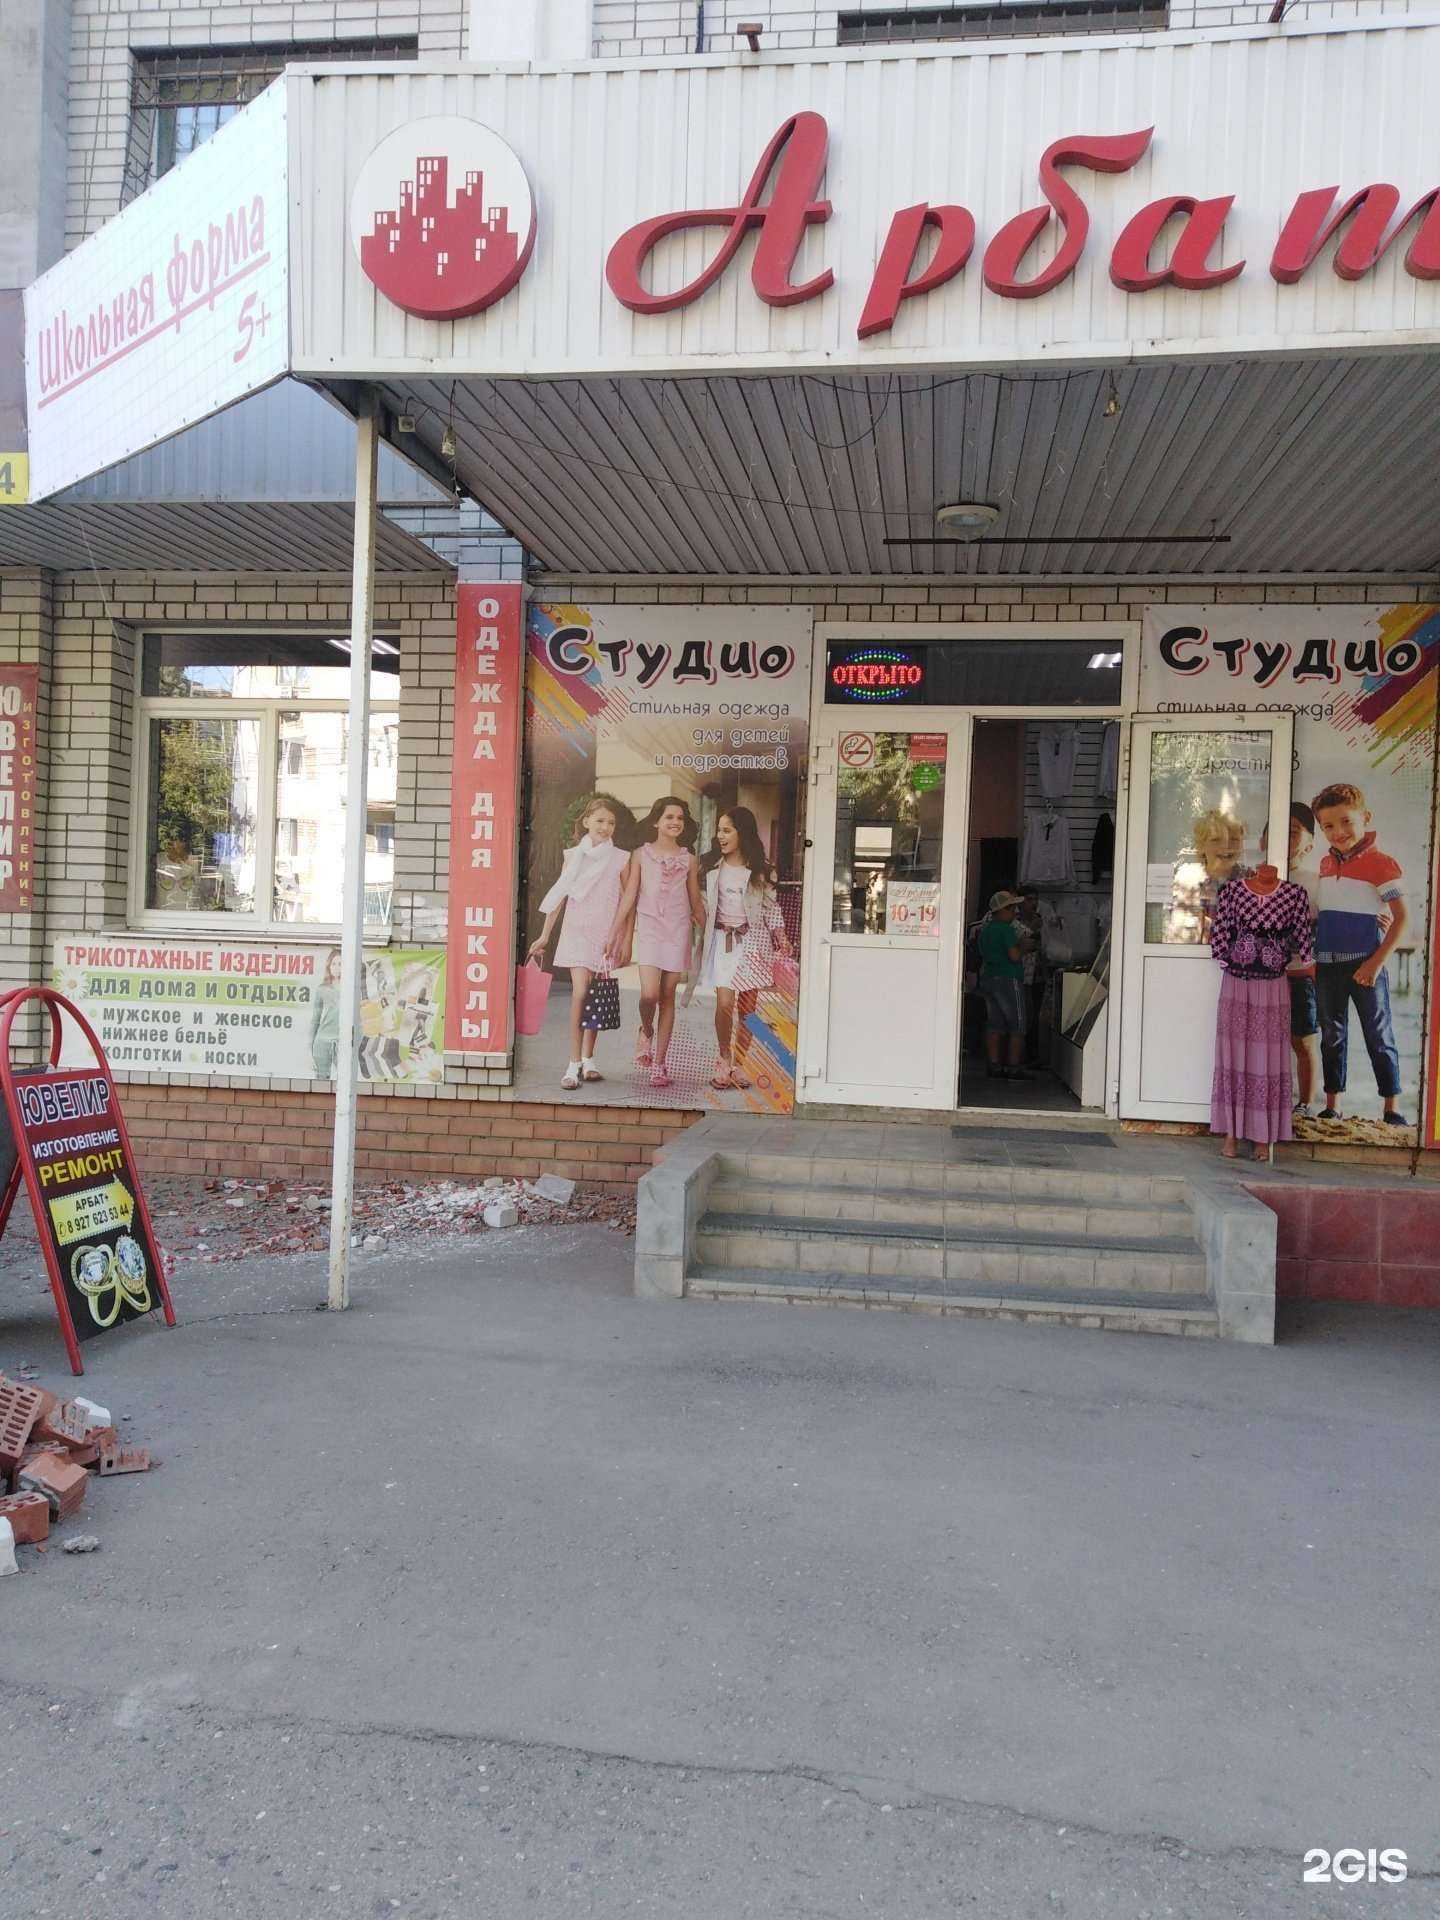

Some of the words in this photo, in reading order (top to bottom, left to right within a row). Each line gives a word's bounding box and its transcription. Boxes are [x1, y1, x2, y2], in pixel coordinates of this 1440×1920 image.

[38, 272, 155, 394] Школьная
[167, 195, 265, 333] форма
[233, 291, 272, 363] 5+
[547, 626, 794, 688] Студио
[1159, 626, 1421, 688] Студио
[470, 598, 502, 760] ОДЕЖДА
[832, 664, 922, 685] ОТКРЫТО
[629, 702, 711, 717] стильная
[718, 703, 789, 722] одежда
[692, 730, 723, 746] для
[730, 725, 789, 747] детей
[655, 756, 664, 766] и
[672, 748, 789, 773] подростков
[19, 701, 33, 908] ИЗГОТОВЛЕНИЕ
[471, 792, 496, 868] ДЛЯ
[890, 904, 937, 922] 10-19
[64, 946, 214, 971] ТРИКОТАЖНЫЕ
[219, 951, 315, 976] ИЗДЕЛИЯ
[461, 906, 494, 1040] ШКОЛЫ
[89, 978, 131, 997] для
[138, 980, 197, 1000] дома
[205, 981, 217, 998] и
[226, 983, 311, 1004] отдыха
[103, 1008, 182, 1026] мужское
[193, 1011, 203, 1025] и
[215, 1013, 293, 1029] женское
[102, 1027, 169, 1042] нижнее
[175, 1027, 228, 1046] бельё
[103, 1046, 182, 1063] колготки
[205, 1051, 258, 1067] носки
[16, 1077, 110, 1126] ЮВЕЛИР
[32, 1129, 120, 1160] ИЗГОТОВЛЕНИЕ
[38, 1149, 125, 1187] РЕМОНТ
[67, 1220, 74, 1234] 8
[75, 1215, 90, 1232] 927
[92, 1210, 108, 1226] 623
[120, 1203, 129, 1217] 44
